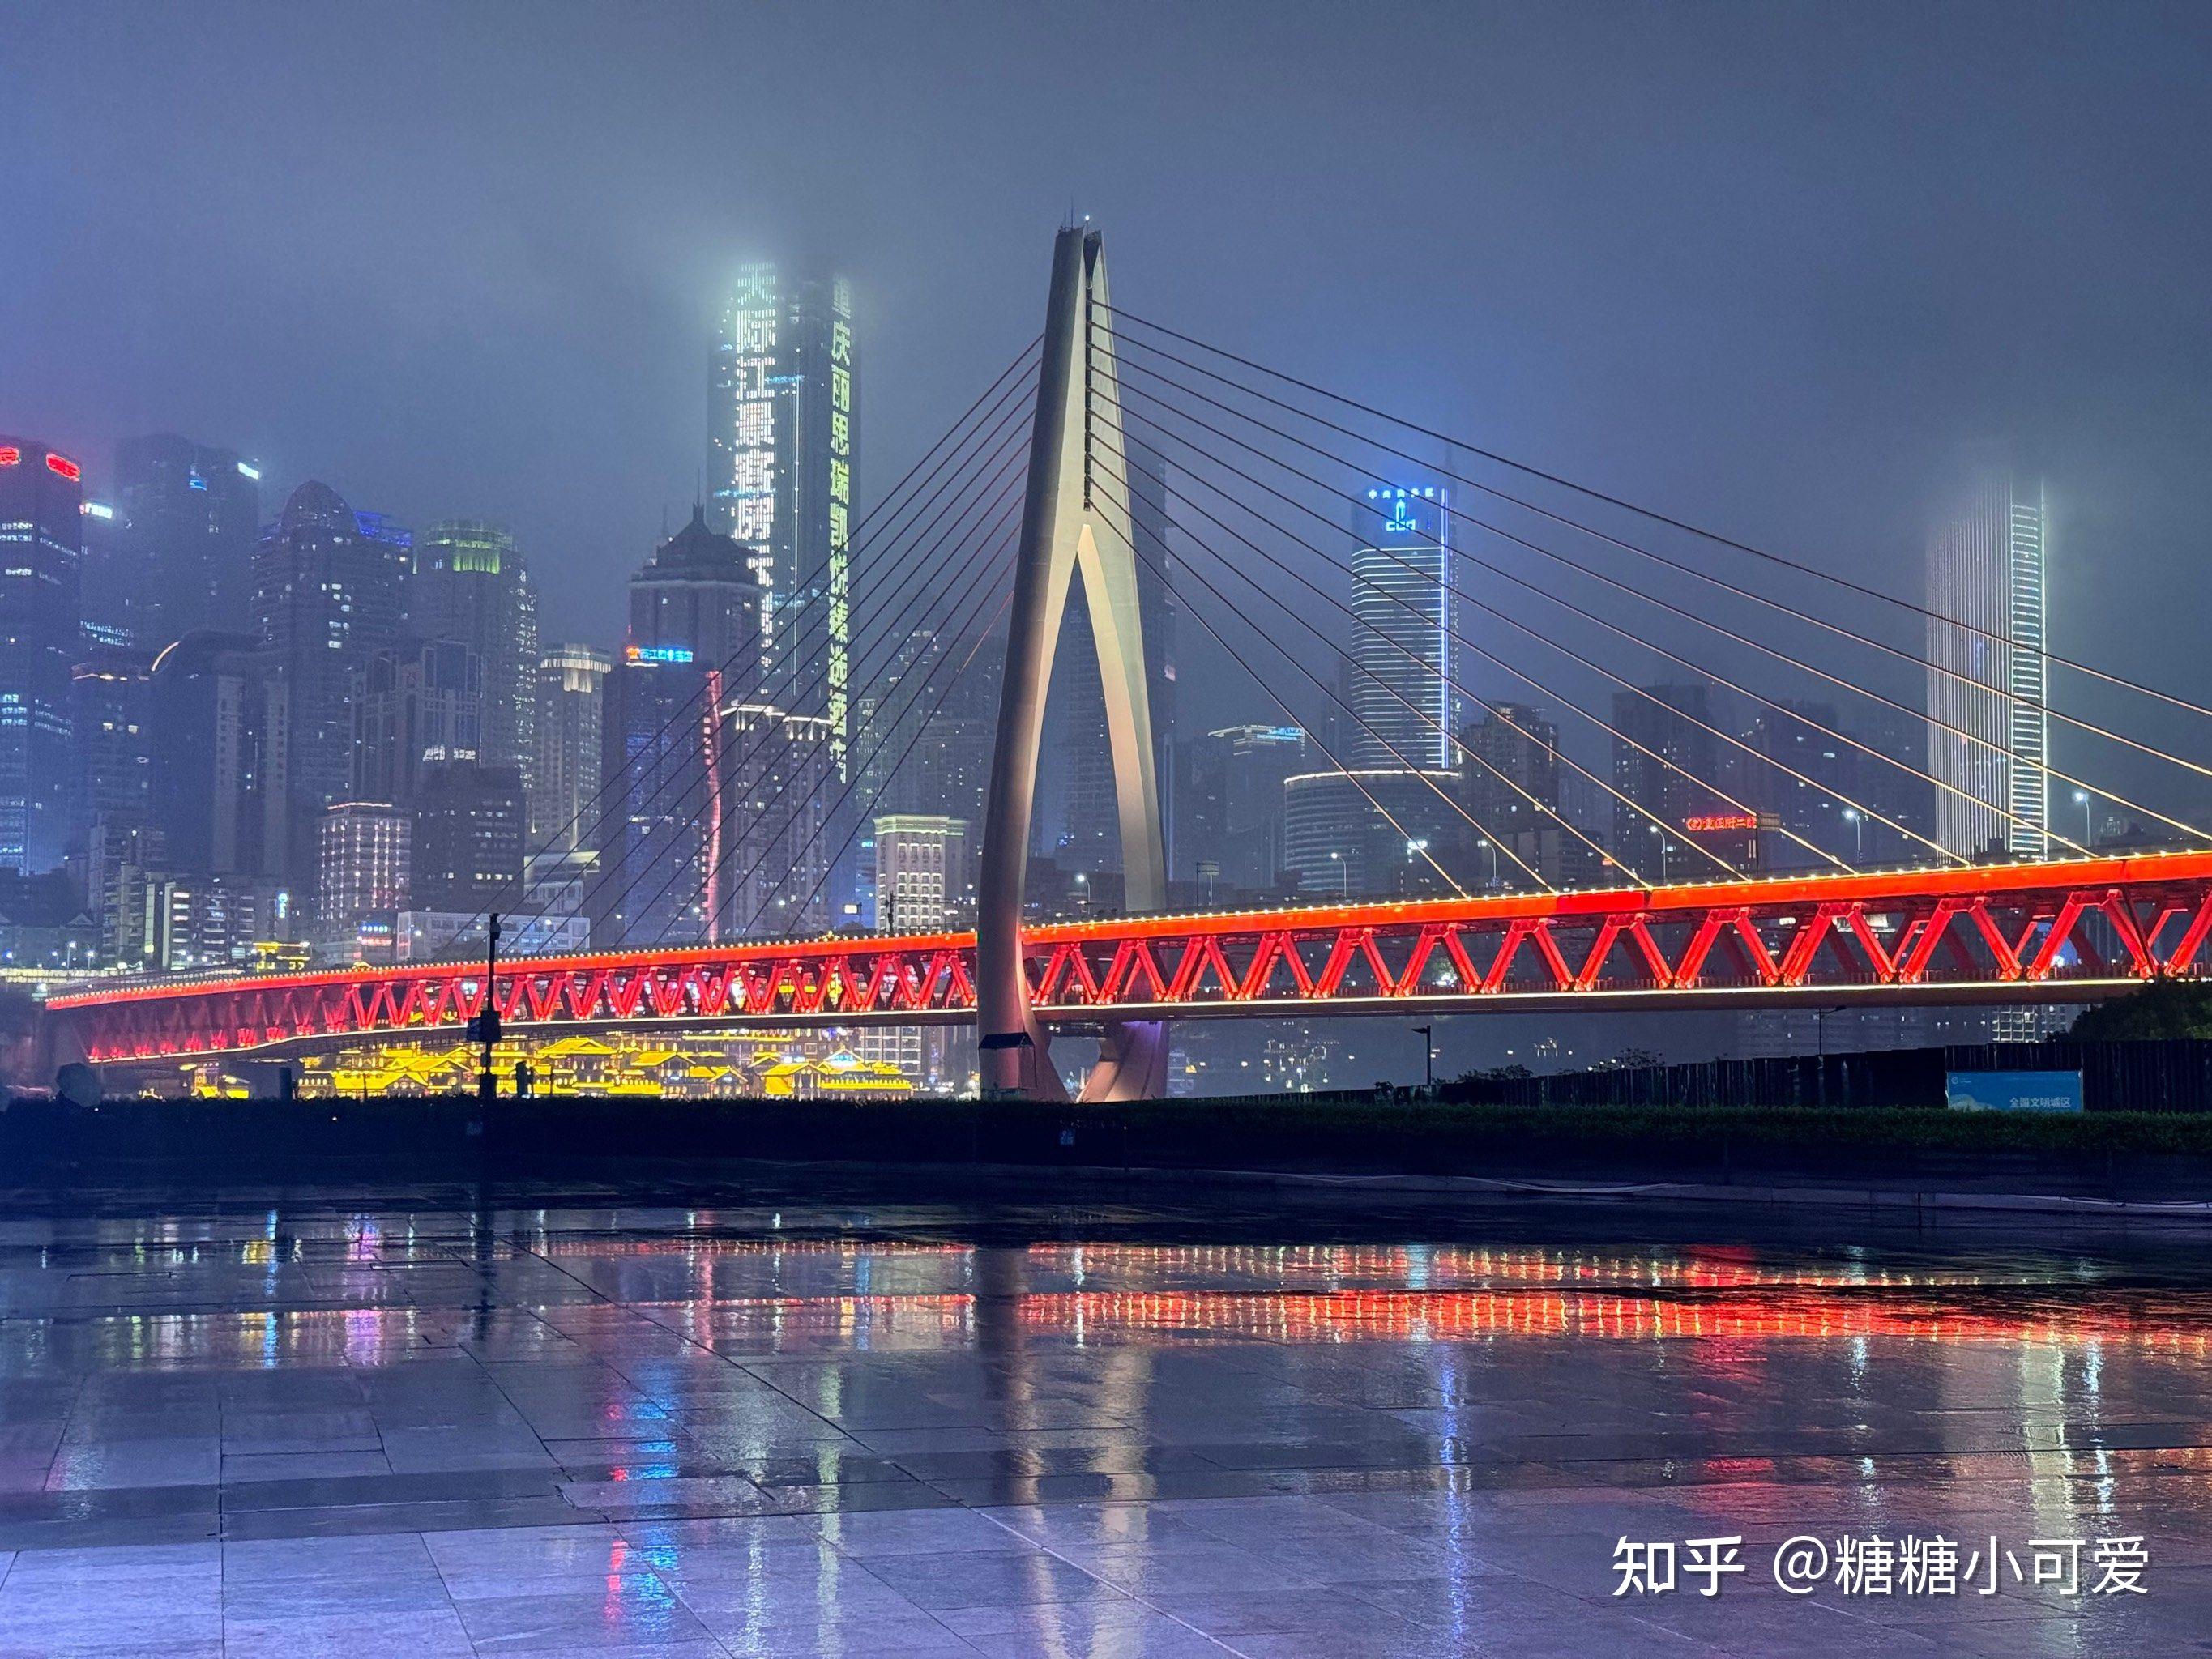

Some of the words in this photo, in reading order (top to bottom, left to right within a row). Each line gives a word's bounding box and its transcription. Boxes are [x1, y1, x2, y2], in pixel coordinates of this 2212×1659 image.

[2009, 1097, 2071, 1108] 全国文明城区
